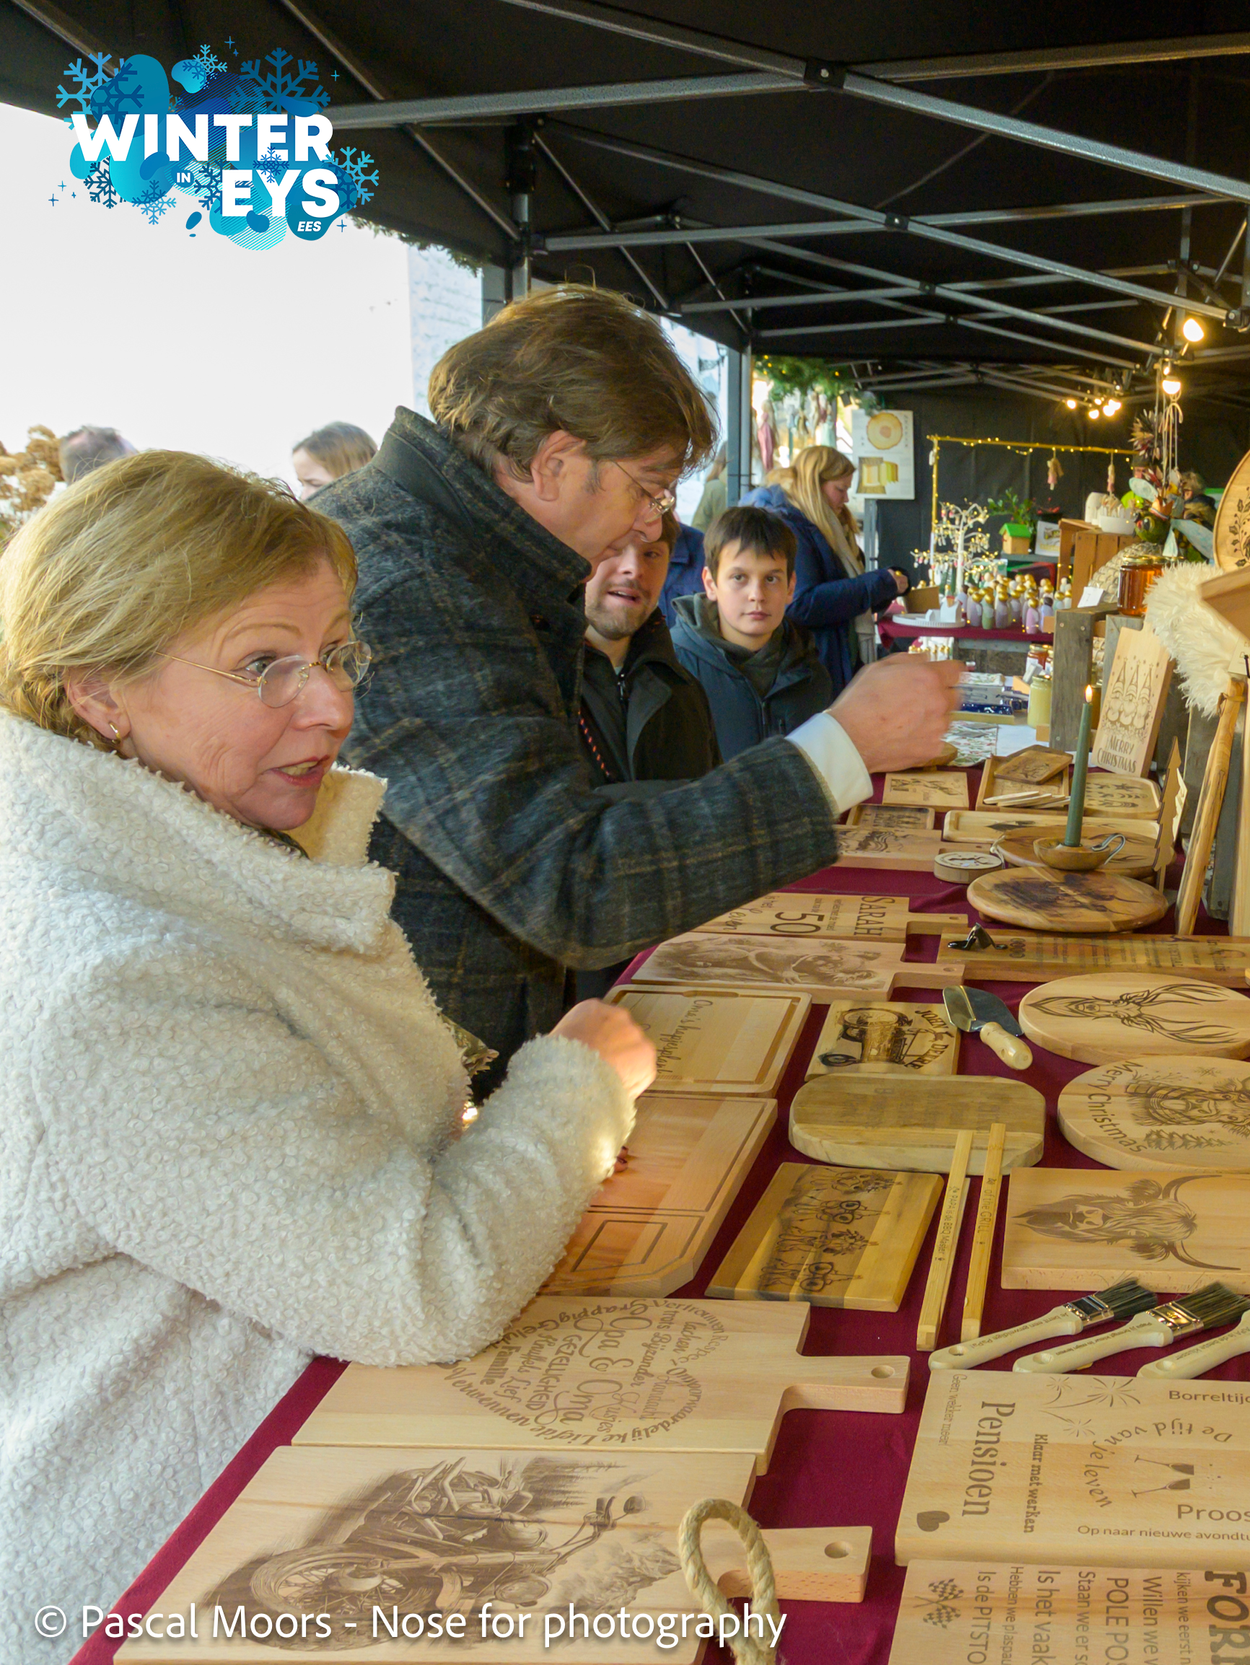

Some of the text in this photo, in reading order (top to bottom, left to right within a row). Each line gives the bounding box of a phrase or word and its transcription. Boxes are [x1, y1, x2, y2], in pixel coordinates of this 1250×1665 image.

[1097, 748, 1137, 773] CHRISTMAS
[1106, 735, 1135, 755] MERRY
[770, 911, 825, 934] 50
[854, 896, 895, 936] SARAH
[915, 1010, 949, 1029] JOHN
[905, 1044, 949, 1070] DEERE
[1087, 1060, 1148, 1153] Merry Christmas
[978, 1211, 992, 1233] GRILL
[558, 1298, 650, 1323] Grappig
[651, 1300, 725, 1334] Vertrouwen
[657, 1310, 679, 1330] trots
[670, 1335, 728, 1366] Respect
[673, 1321, 707, 1353] lachen
[480, 1346, 521, 1385] Familie
[493, 1334, 558, 1403] Knuffels Lief
[534, 1316, 653, 1425] Opa & Oma
[444, 1367, 531, 1426] Verwennen
[589, 1392, 640, 1433] Kusjes
[639, 1375, 684, 1421] Aandacht
[938, 1373, 967, 1446] Geen wekker meer!
[530, 1425, 598, 1445] Liefde
[962, 1401, 1016, 1517] Pensioen
[1083, 1418, 1233, 1508] De tijd van je leven
[1023, 1433, 1048, 1533] Klaar met werken
[1077, 1525, 1100, 1537] Op
[1103, 1527, 1135, 1537] naar
[1140, 1528, 1192, 1539] nieuwe
[977, 1571, 997, 1583] Is
[1008, 1566, 1024, 1605] Hebben
[1077, 1571, 1096, 1608] Staan
[1173, 1572, 1191, 1604] kijken
[975, 1586, 995, 1603] de
[1105, 1577, 1129, 1626] POLE
[1142, 1576, 1163, 1626] Willen
[1005, 1607, 1016, 1623] we
[1031, 1570, 1061, 1665] Is het vaak
[1075, 1611, 1090, 1632] we
[1178, 1605, 1190, 1623] we
[1075, 1635, 1089, 1648] er
[1143, 1630, 1159, 1655] we
[1178, 1625, 1192, 1651] eerst
